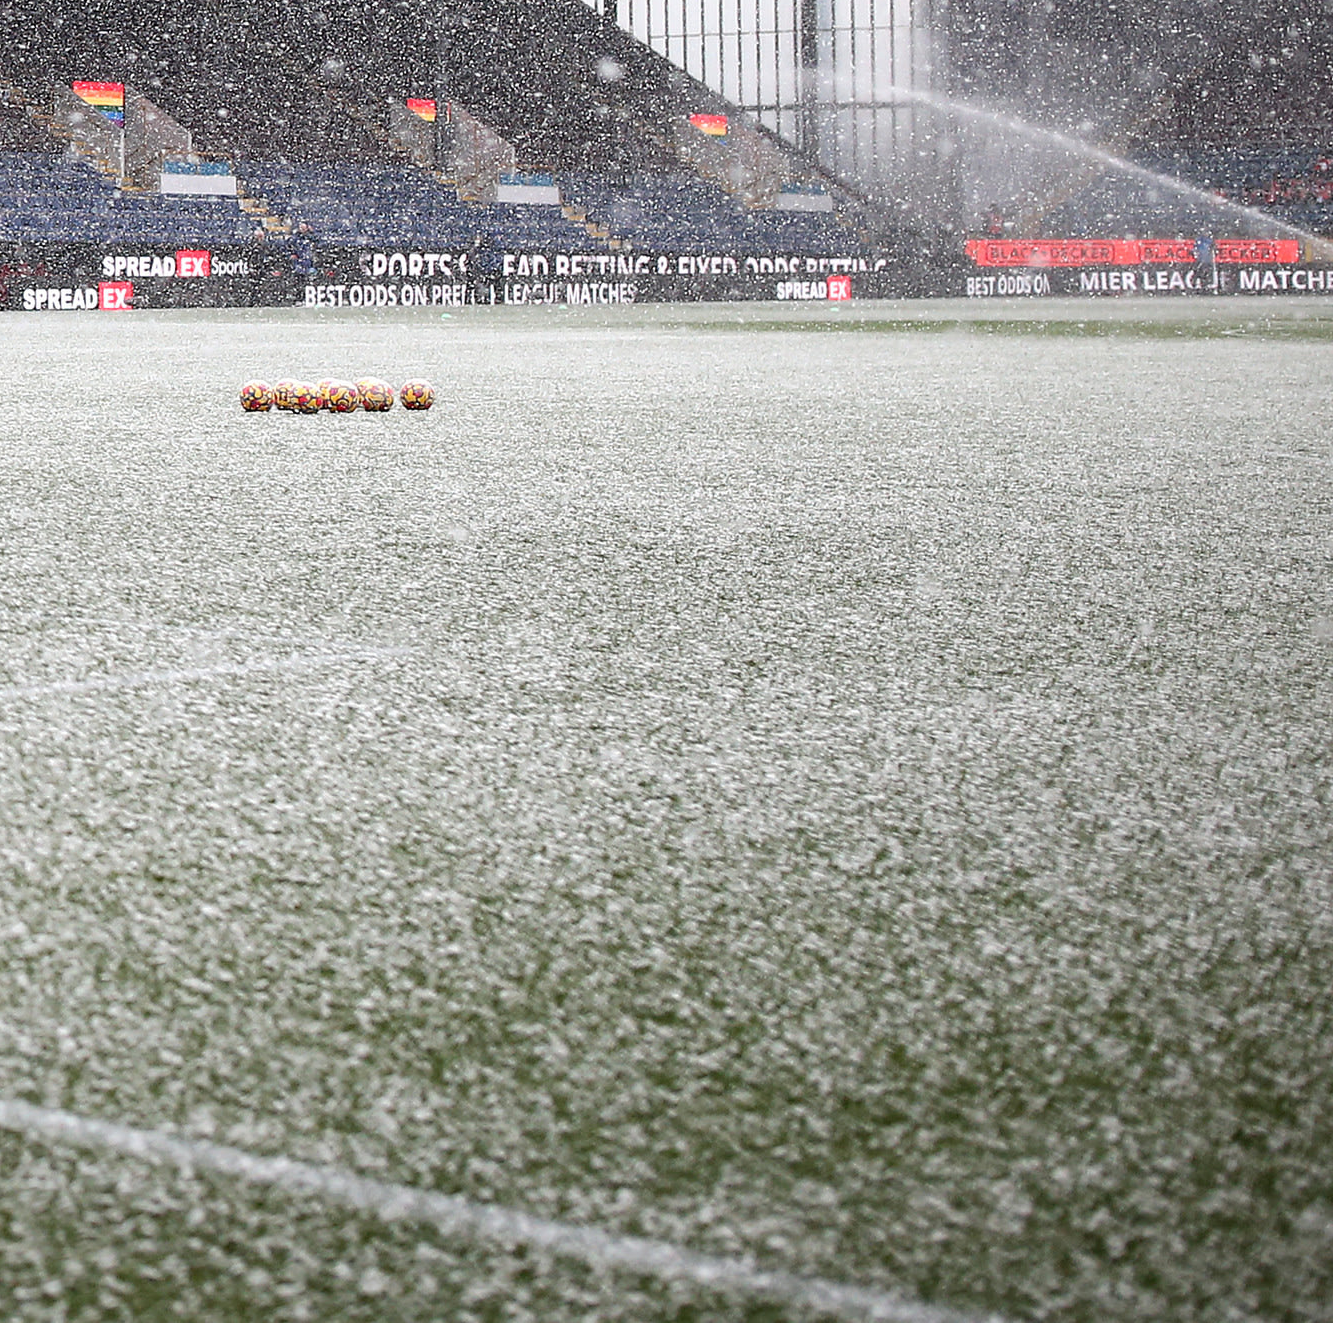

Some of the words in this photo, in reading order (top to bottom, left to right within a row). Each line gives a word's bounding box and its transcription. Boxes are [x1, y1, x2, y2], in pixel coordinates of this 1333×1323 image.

[101, 256, 176, 277] SPREAD
[305, 285, 346, 307] BEST
[349, 284, 397, 307] ODDS
[401, 284, 427, 306] ON
[566, 283, 636, 305] MATCHES
[776, 282, 827, 300] SPREAD
[966, 276, 996, 296] BEST
[997, 275, 1032, 295] ODDS
[23, 288, 99, 311] SPREAD
